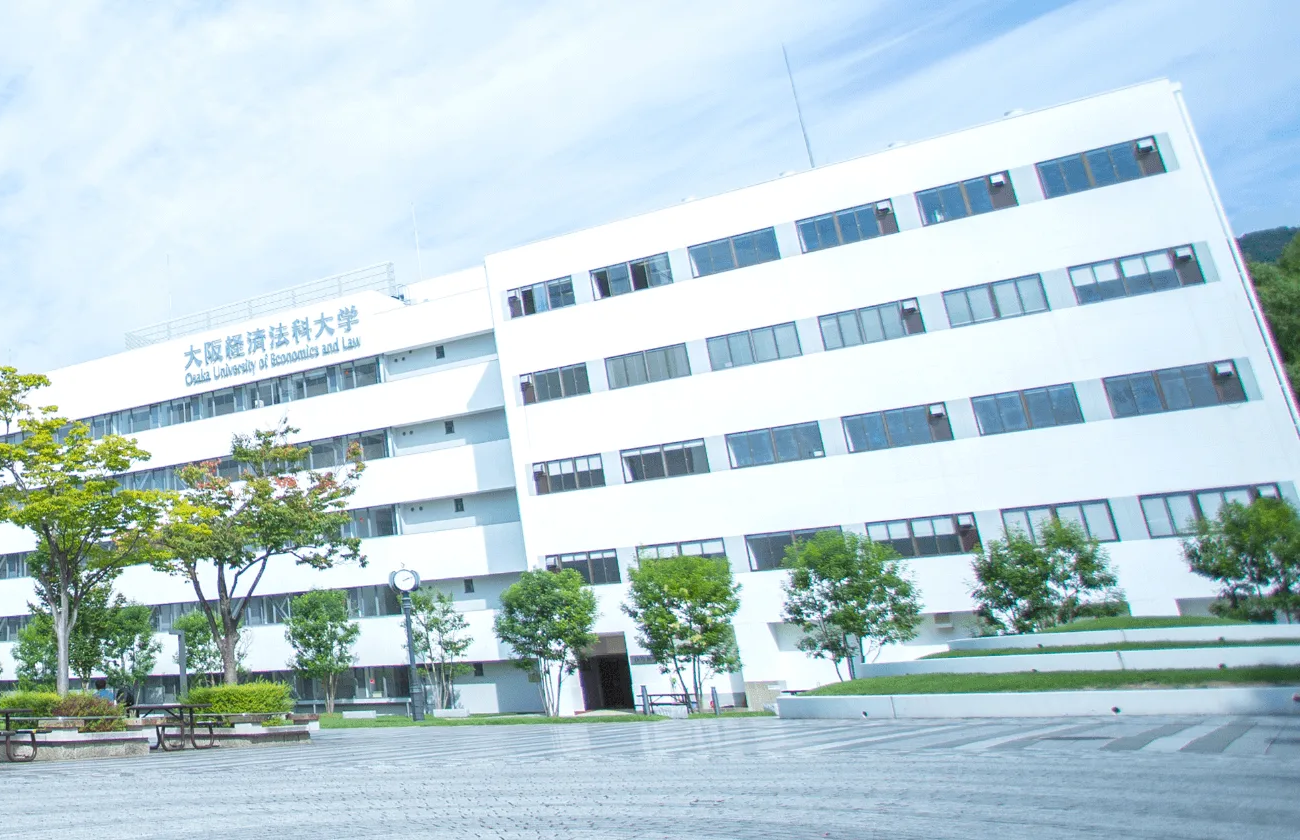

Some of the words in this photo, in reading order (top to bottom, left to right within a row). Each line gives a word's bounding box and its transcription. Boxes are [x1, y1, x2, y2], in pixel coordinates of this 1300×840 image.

[184, 305, 359, 371] 大阪経済法科大学
[185, 369, 211, 387] Osaka
[213, 358, 256, 380] University
[259, 354, 268, 370] of
[270, 344, 319, 367] Economics
[322, 337, 339, 356] and
[342, 336, 361, 351] Law
